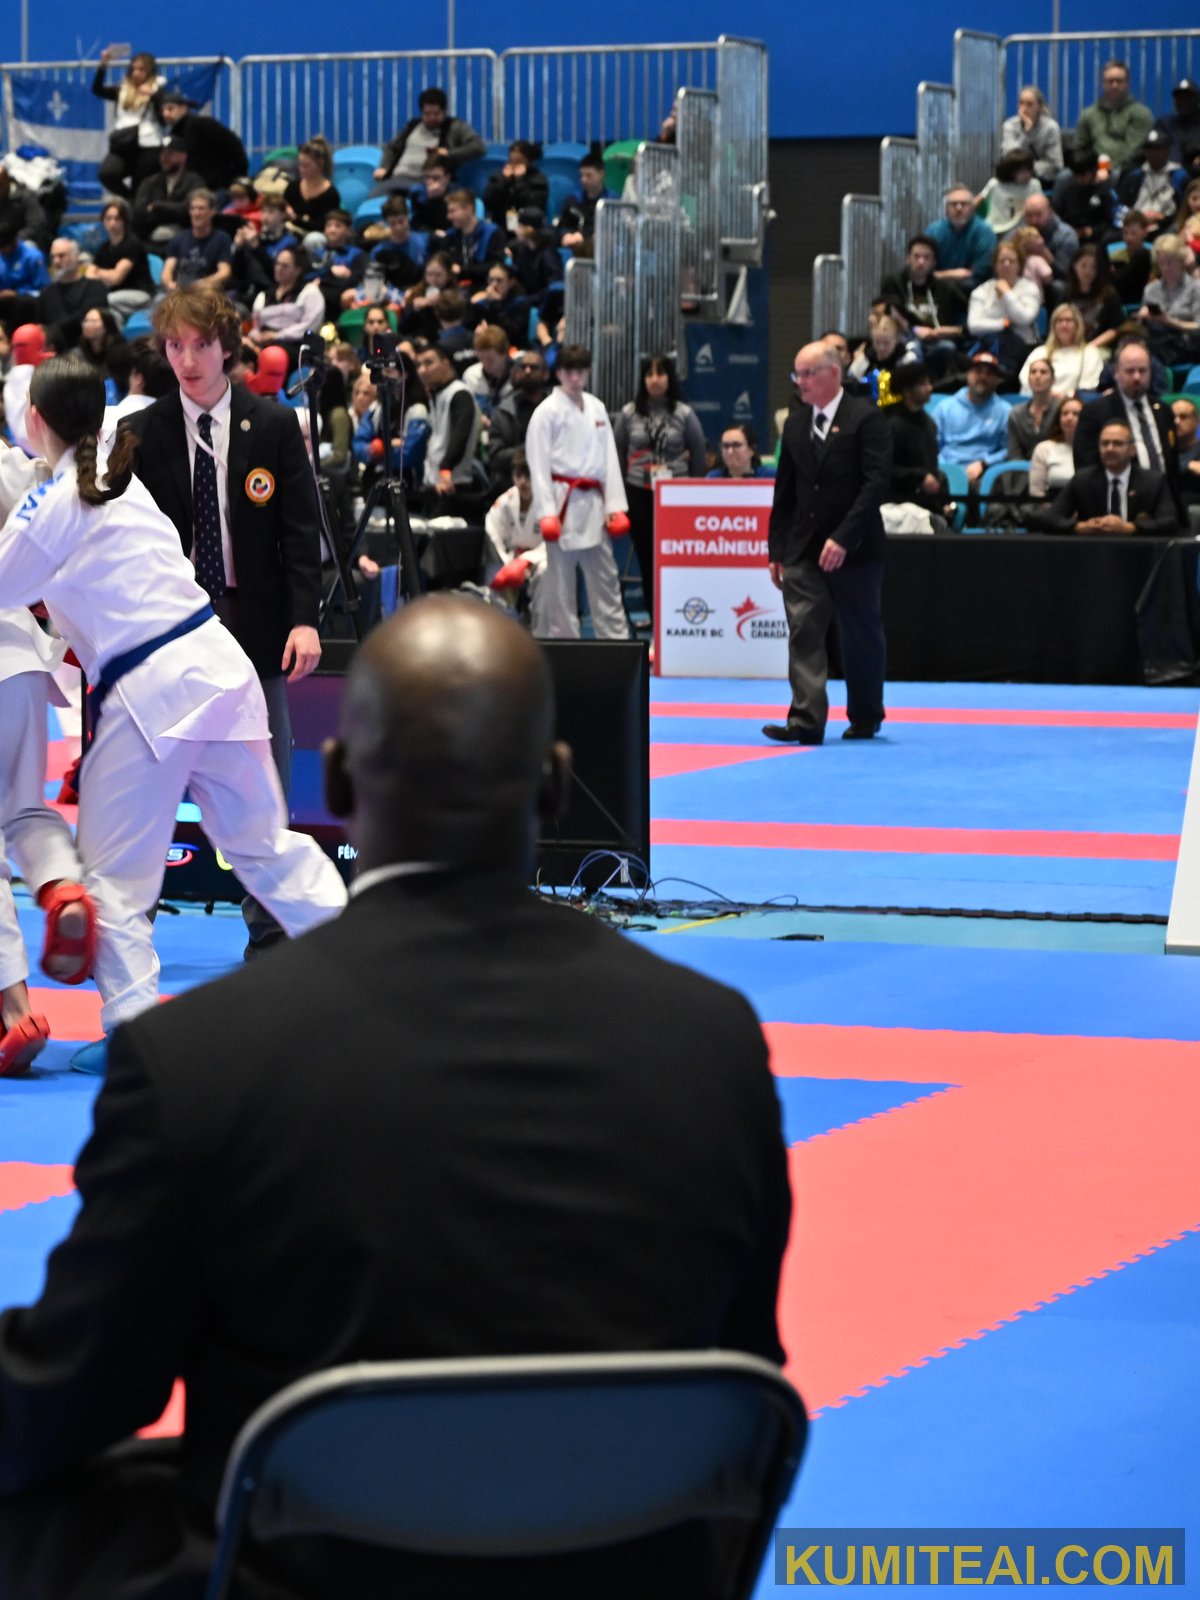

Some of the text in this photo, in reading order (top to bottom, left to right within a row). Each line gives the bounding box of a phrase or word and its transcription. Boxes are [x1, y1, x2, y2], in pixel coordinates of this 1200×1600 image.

[694, 516, 758, 532] COACH
[666, 628, 724, 637] KARATE BC
